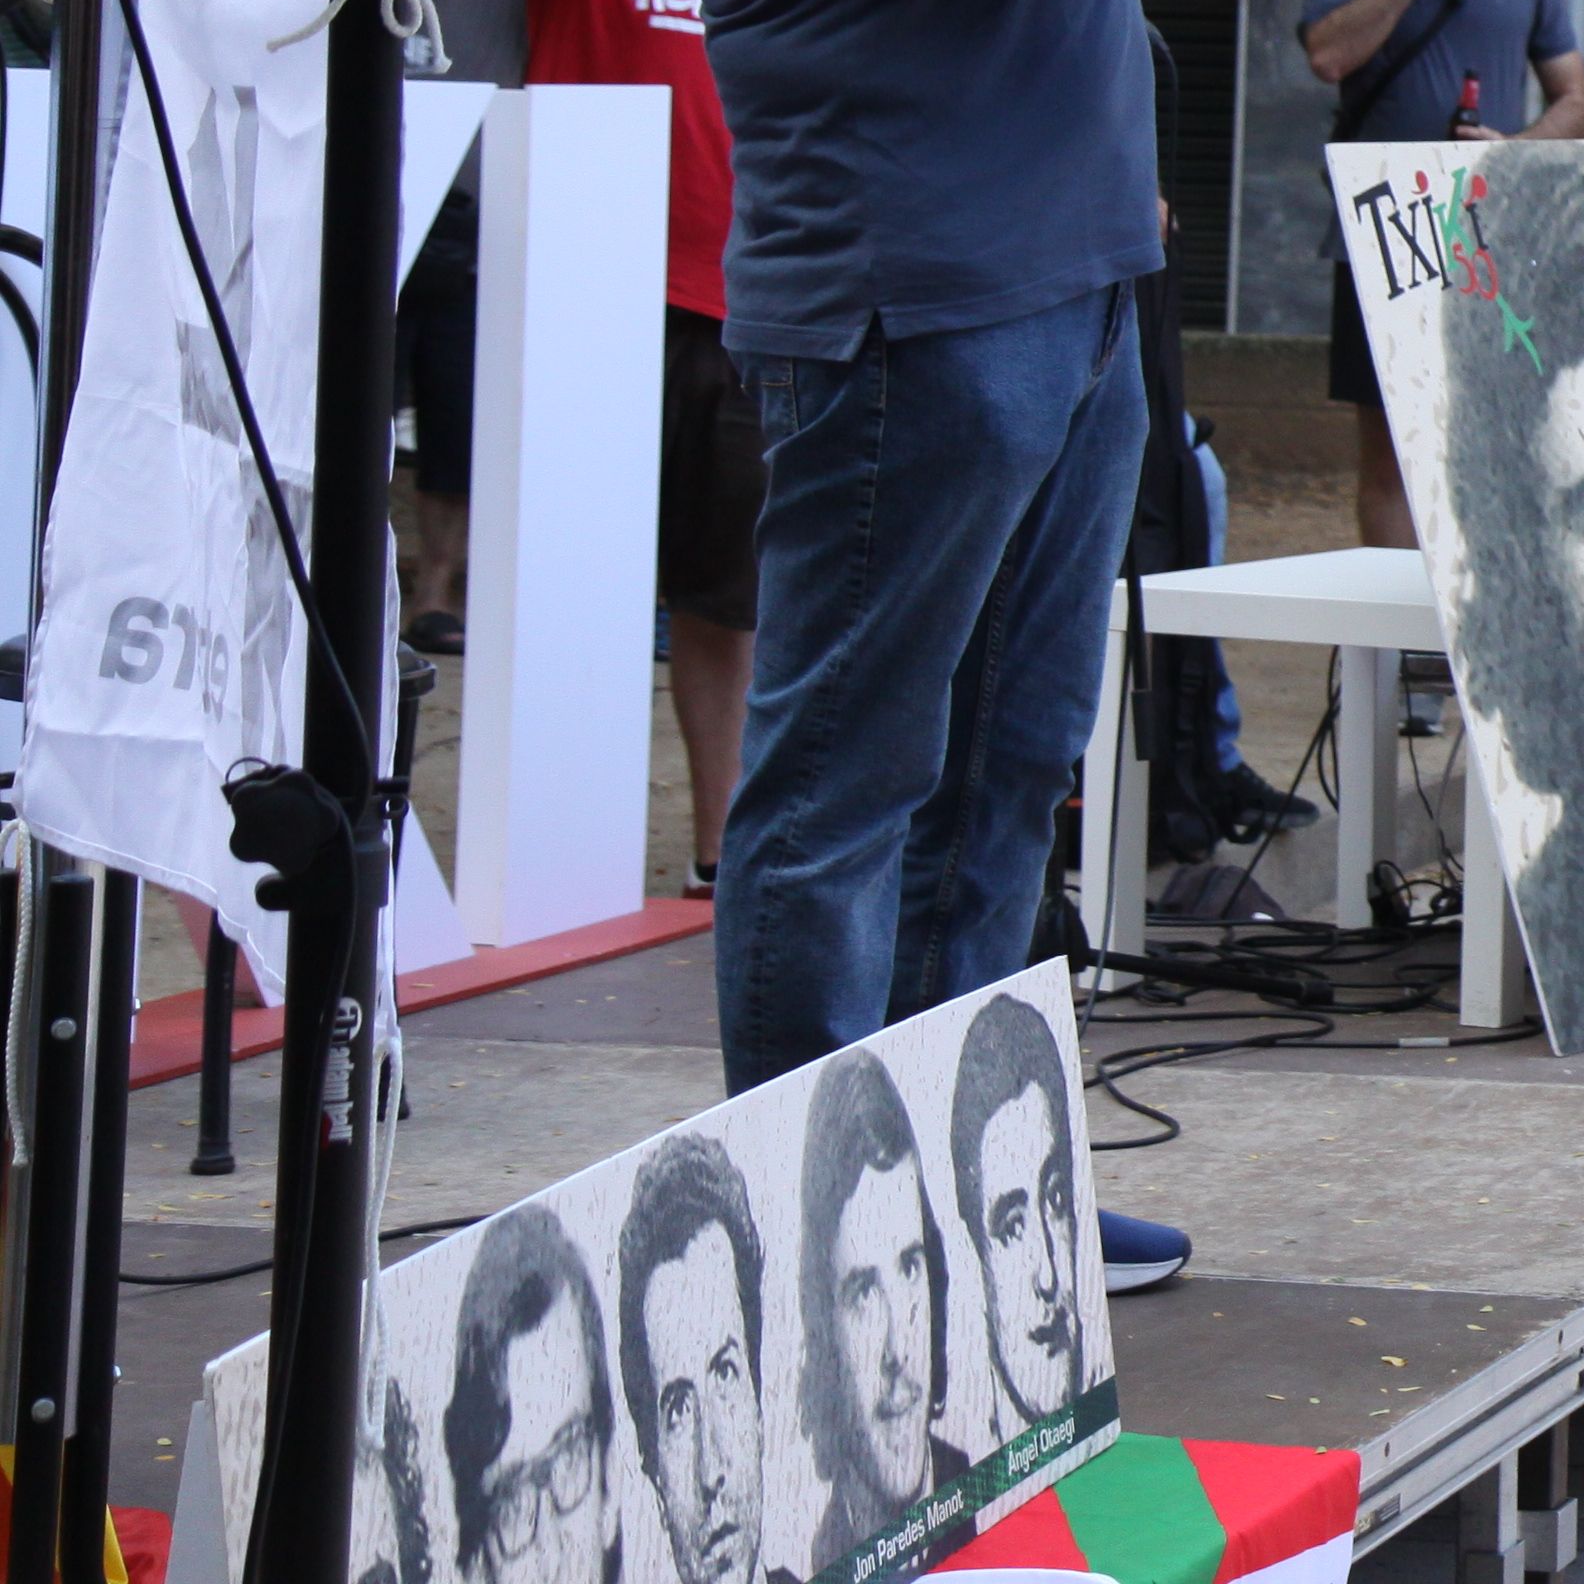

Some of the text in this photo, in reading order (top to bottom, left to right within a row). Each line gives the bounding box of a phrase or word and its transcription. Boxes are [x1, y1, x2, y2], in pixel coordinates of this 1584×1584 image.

[1008, 1411, 1075, 1476] Ángel Otaegi
[853, 1488, 964, 1584] Jon Paredes Manot
